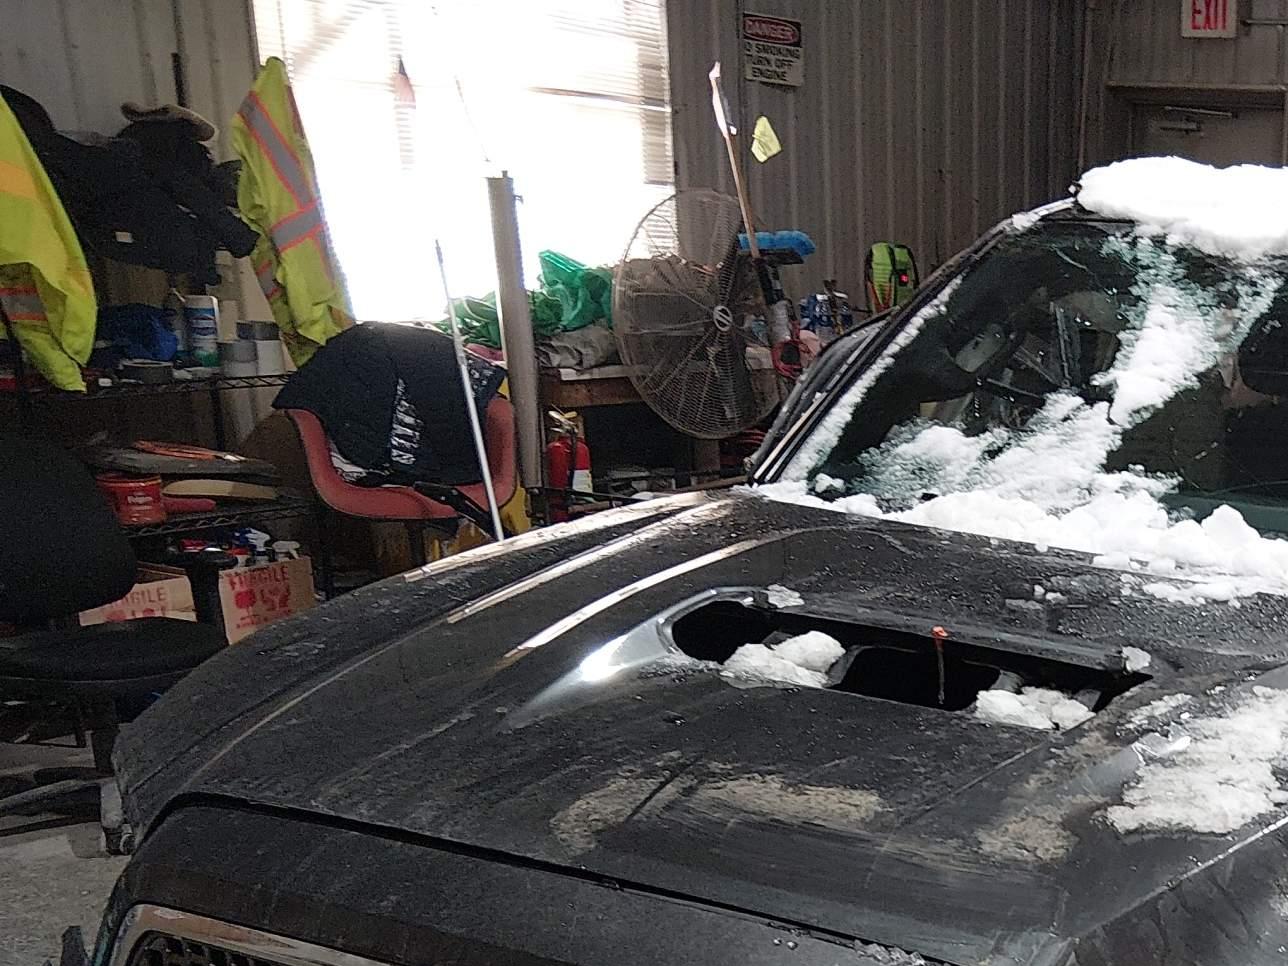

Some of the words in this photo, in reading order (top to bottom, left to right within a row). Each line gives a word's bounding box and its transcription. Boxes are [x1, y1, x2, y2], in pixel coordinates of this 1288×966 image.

[745, 19, 793, 40] DANGER
[755, 43, 800, 60] SMOKING
[775, 58, 794, 69] OFF
[752, 67, 787, 82] ENGINE
